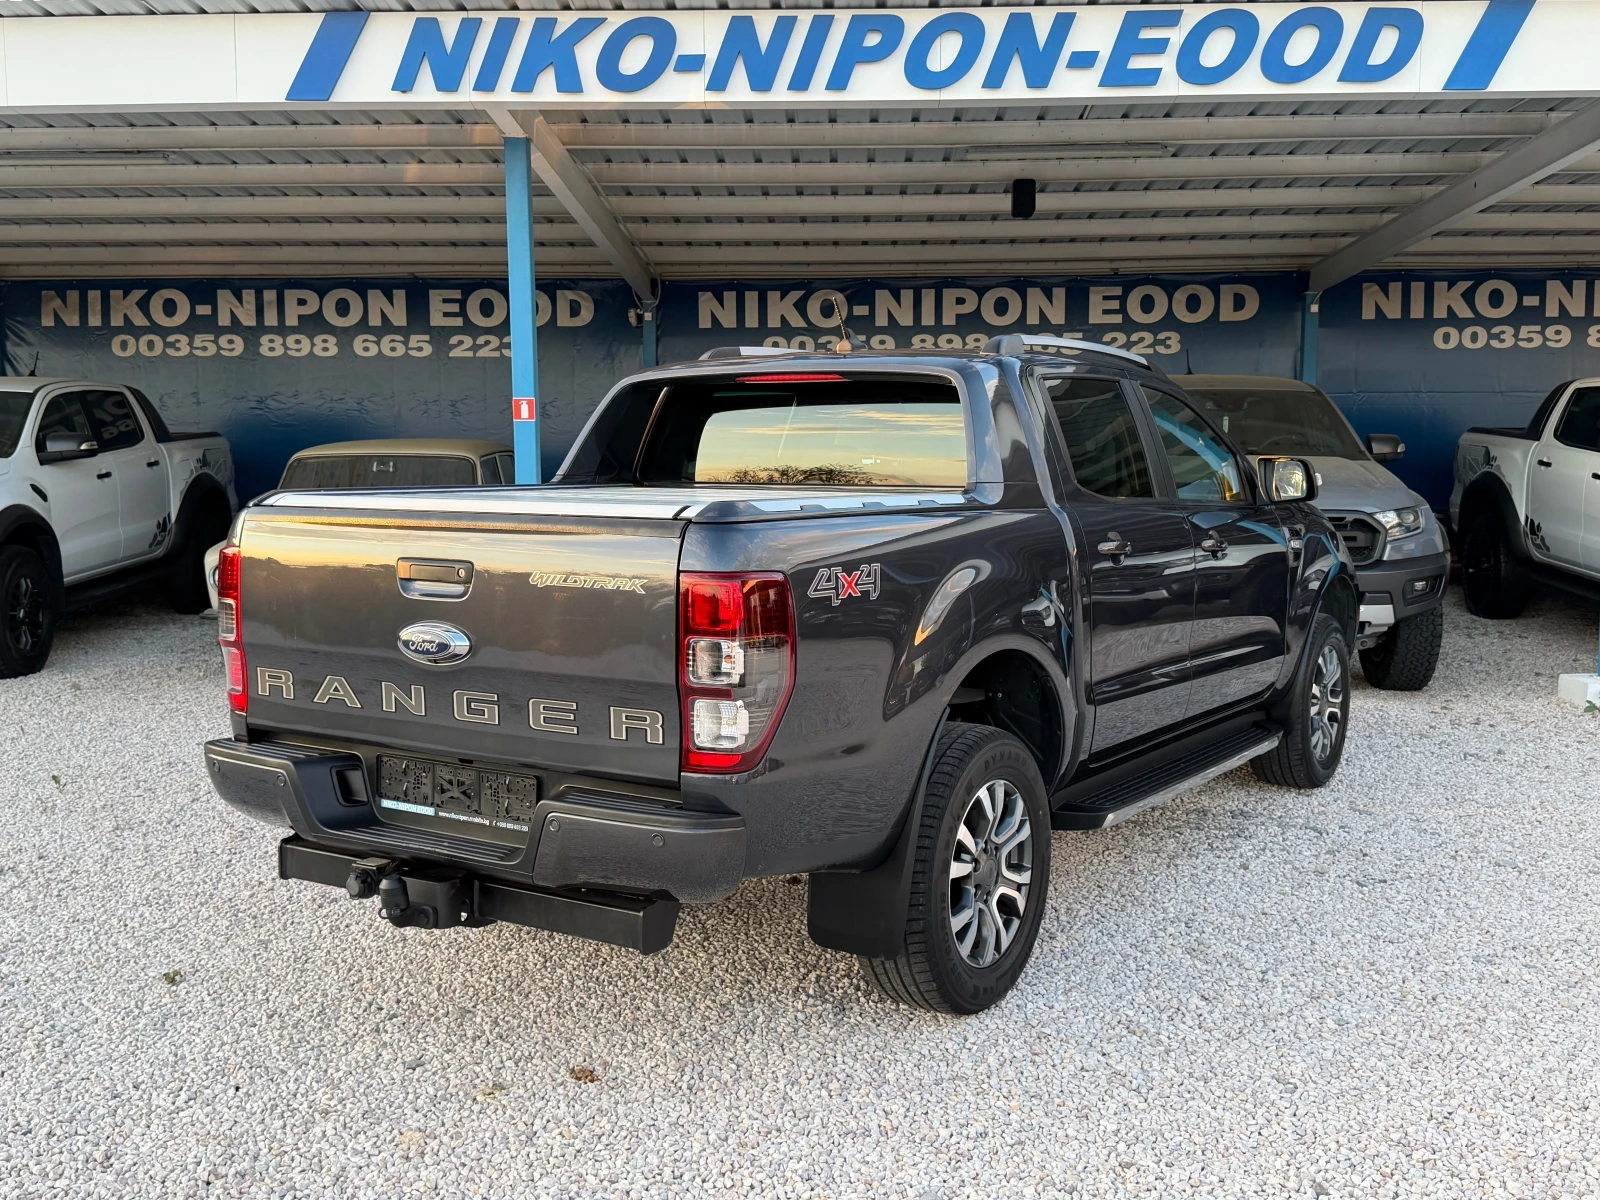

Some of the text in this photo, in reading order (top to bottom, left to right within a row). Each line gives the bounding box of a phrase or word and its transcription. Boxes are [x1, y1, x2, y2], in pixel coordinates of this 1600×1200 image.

[391, 6, 1425, 93] NIKO-NIPON-EOOD
[41, 288, 408, 327] NIKO-NIPON
[698, 284, 1260, 328] NIKO-NIPON EOOD
[111, 333, 245, 357] 00359
[259, 333, 339, 357] 898
[353, 334, 433, 358] 665
[1433, 325, 1572, 350] 00359
[529, 570, 648, 595] WILDTRAK
[409, 633, 439, 653] Ford
[256, 667, 664, 745] RANGER
